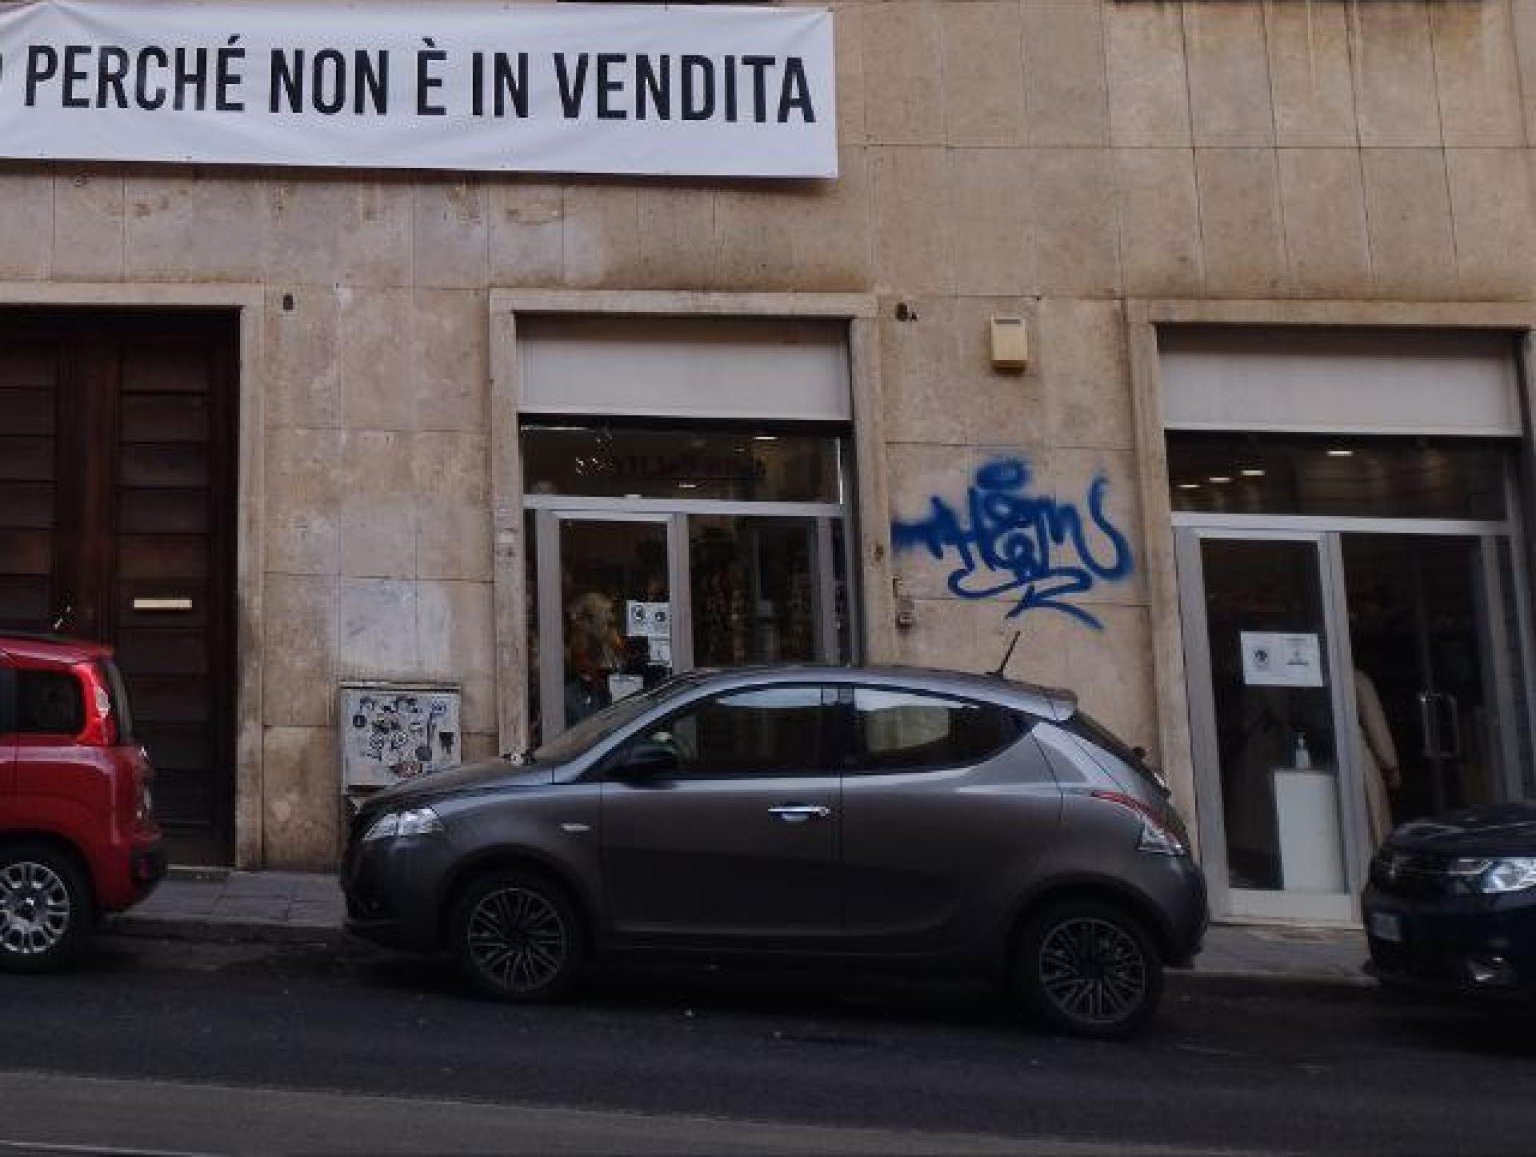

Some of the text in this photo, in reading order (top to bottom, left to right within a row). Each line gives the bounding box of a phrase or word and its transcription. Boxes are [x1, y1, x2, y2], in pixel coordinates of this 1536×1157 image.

[24, 34, 246, 112] PERCHÉ
[269, 47, 389, 116] NON
[416, 37, 447, 116] È
[471, 52, 529, 119] IN
[553, 52, 816, 123] VENDITA
